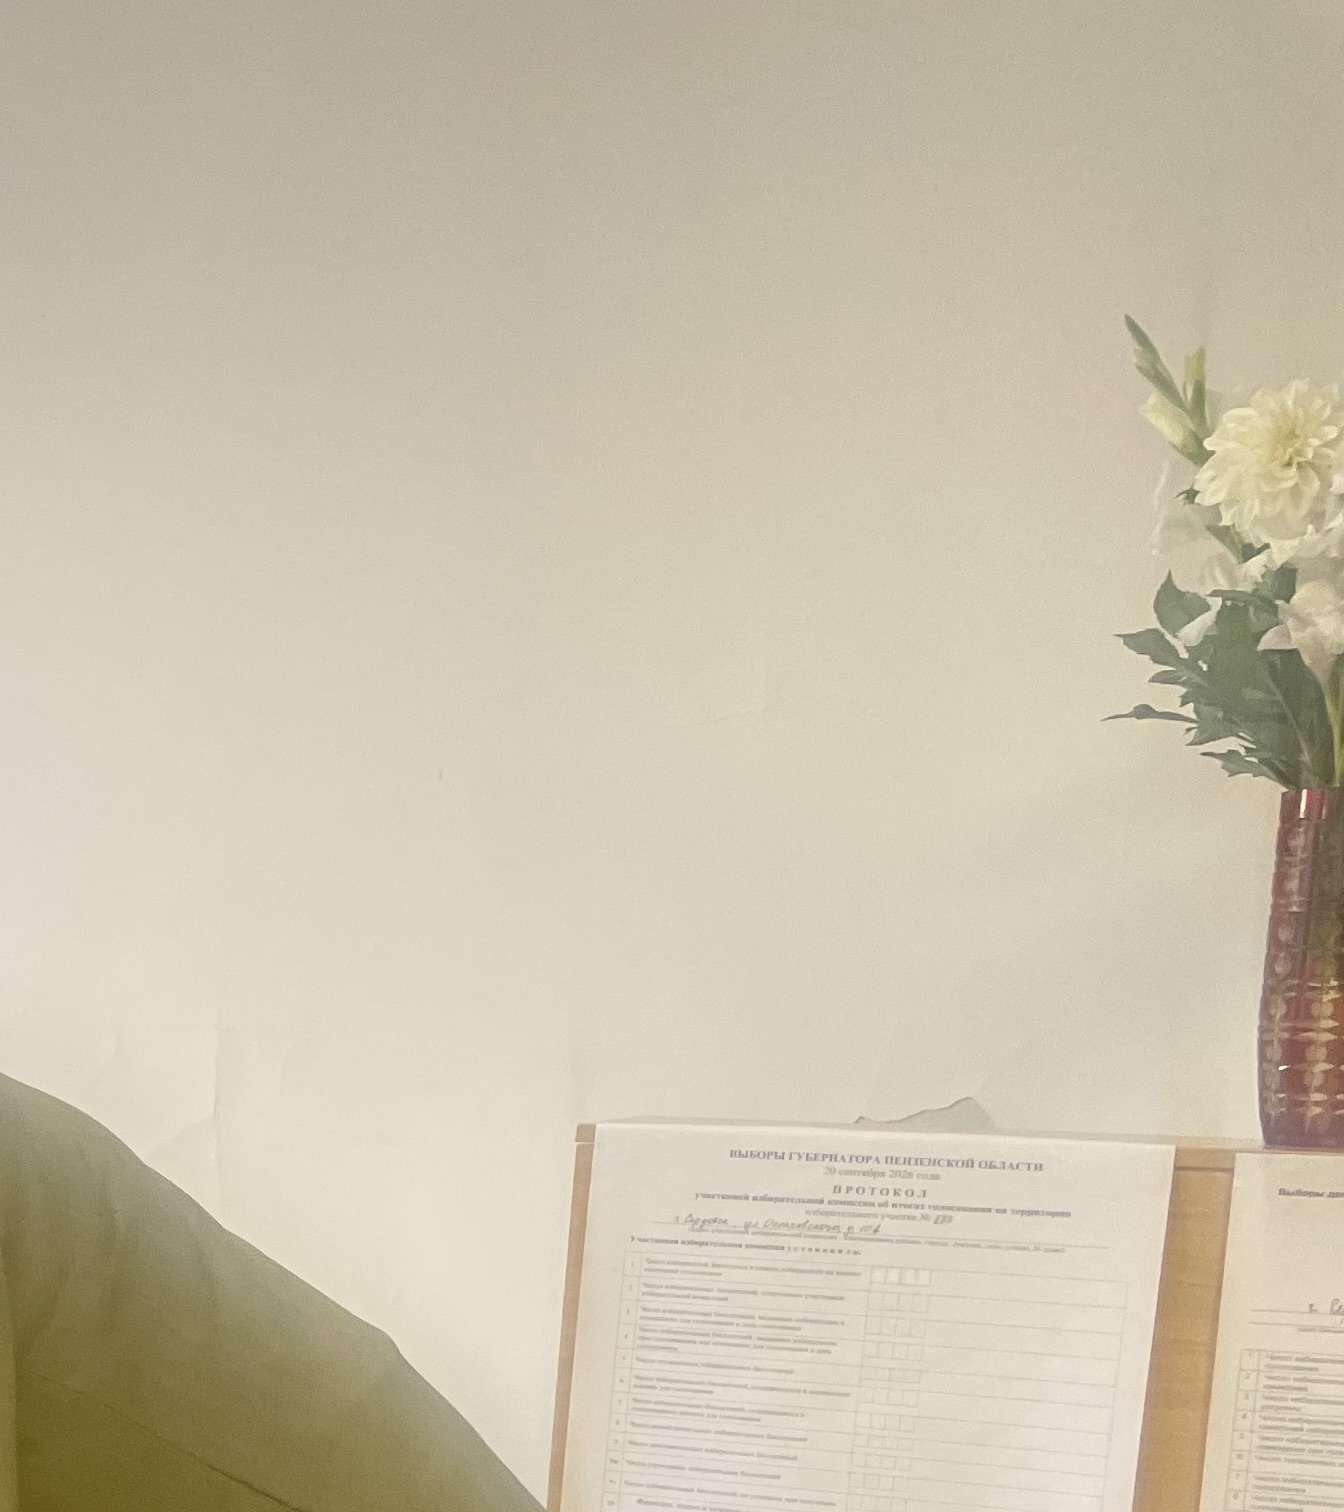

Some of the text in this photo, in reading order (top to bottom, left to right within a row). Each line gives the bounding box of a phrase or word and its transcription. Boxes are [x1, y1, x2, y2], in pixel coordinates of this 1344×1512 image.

[728, 1149, 1044, 1172] ВЫБОРЫ ГУБЕРНАТОРА ПЕНЗЕНСКОЙ ОБЛАСТИ
